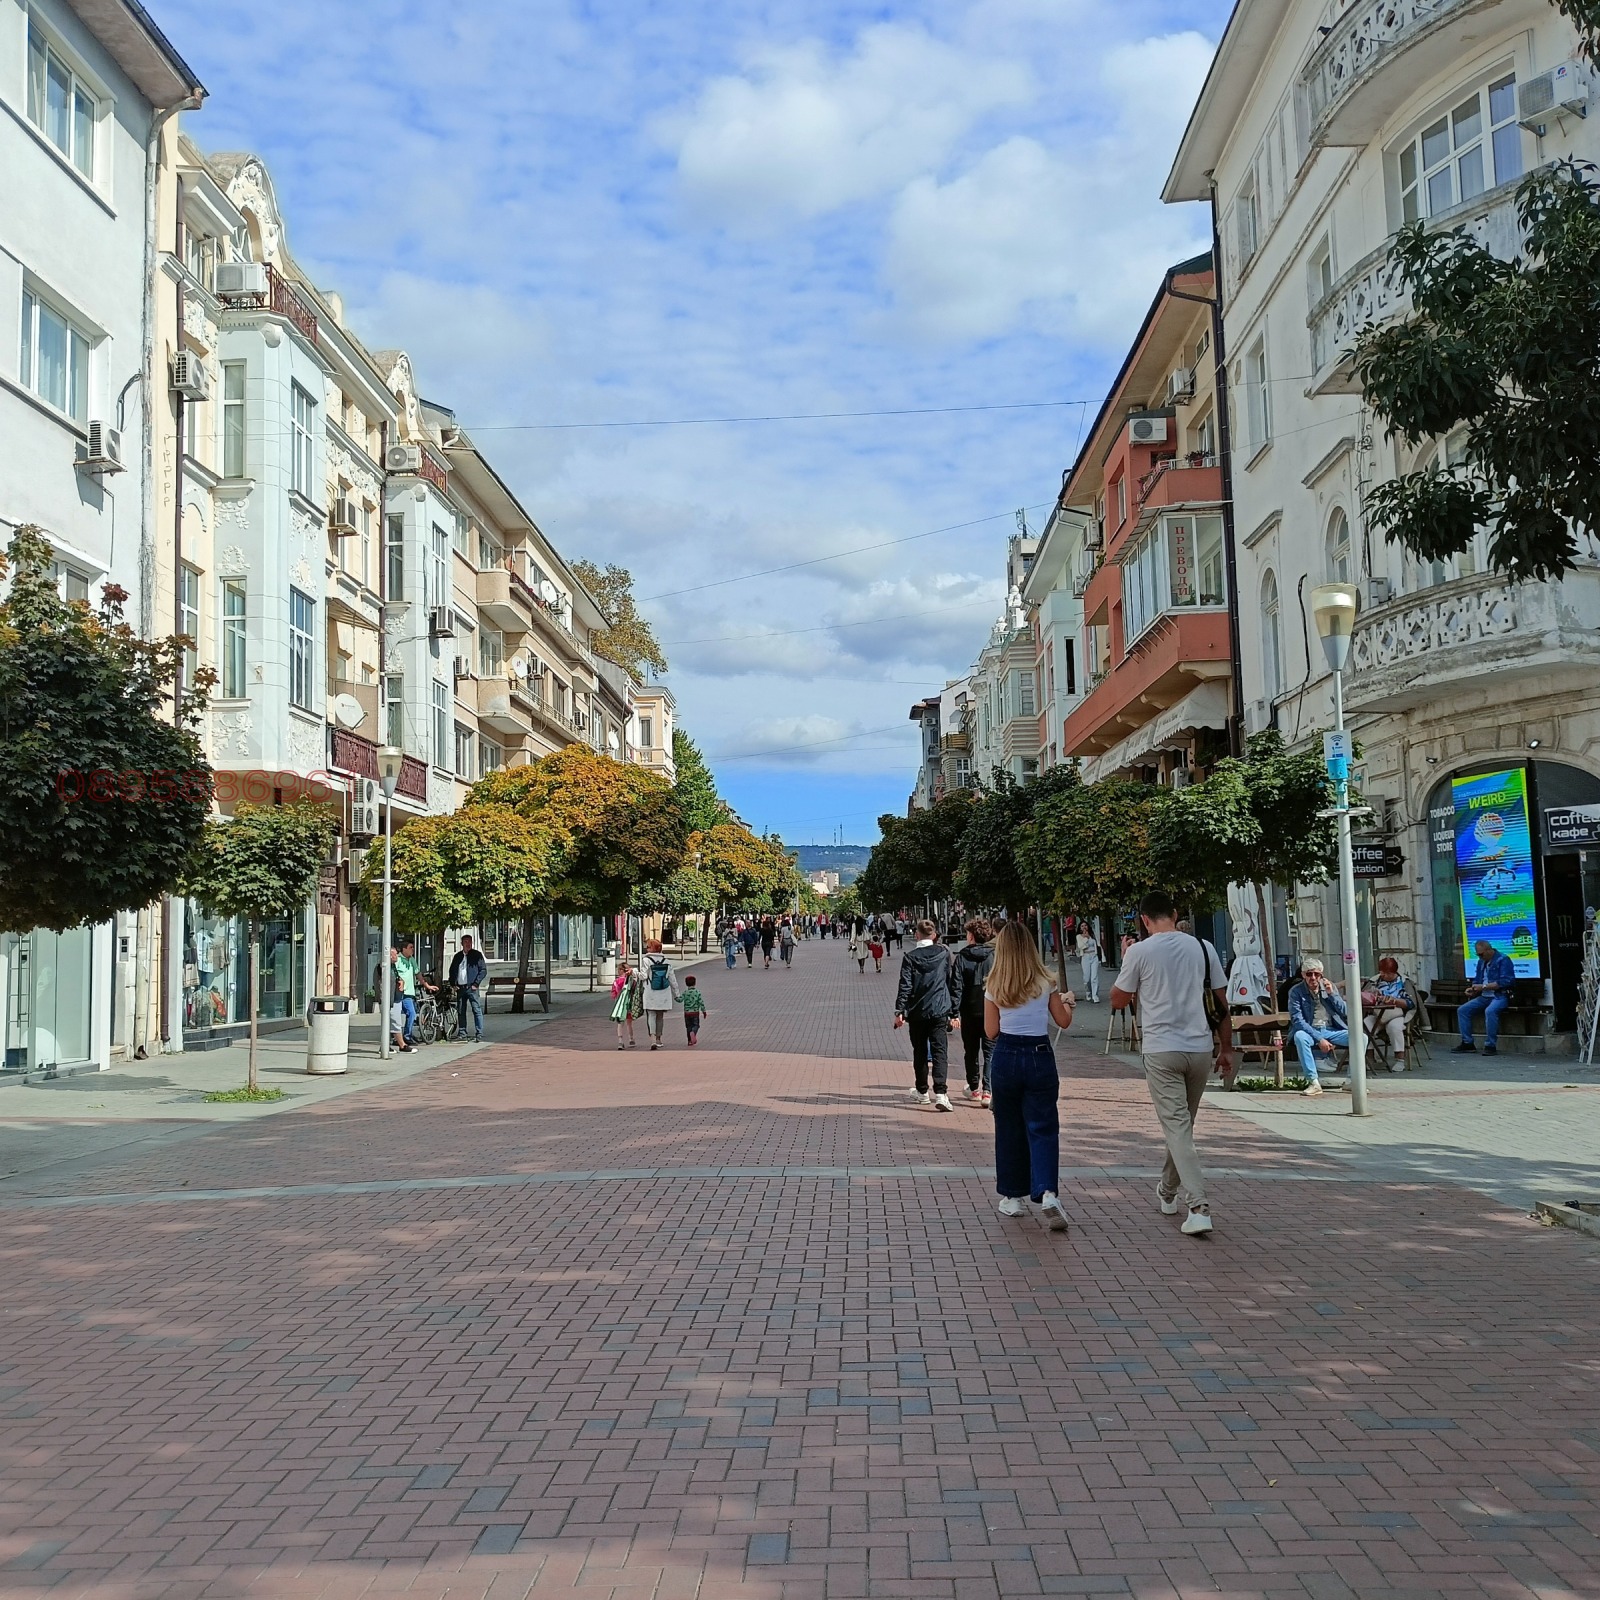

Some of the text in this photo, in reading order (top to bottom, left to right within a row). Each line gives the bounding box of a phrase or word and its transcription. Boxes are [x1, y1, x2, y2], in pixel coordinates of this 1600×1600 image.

[1175, 526, 1190, 596] ПРЕВОДИ
[1469, 792, 1506, 809] WEIRD
[1430, 805, 1455, 818] TOBACCO
[1433, 829, 1455, 841] LIQUEUR
[1552, 827, 1589, 839] кафе
[1436, 841, 1453, 853] STORE
[1473, 911, 1528, 928] WONDERFUL
